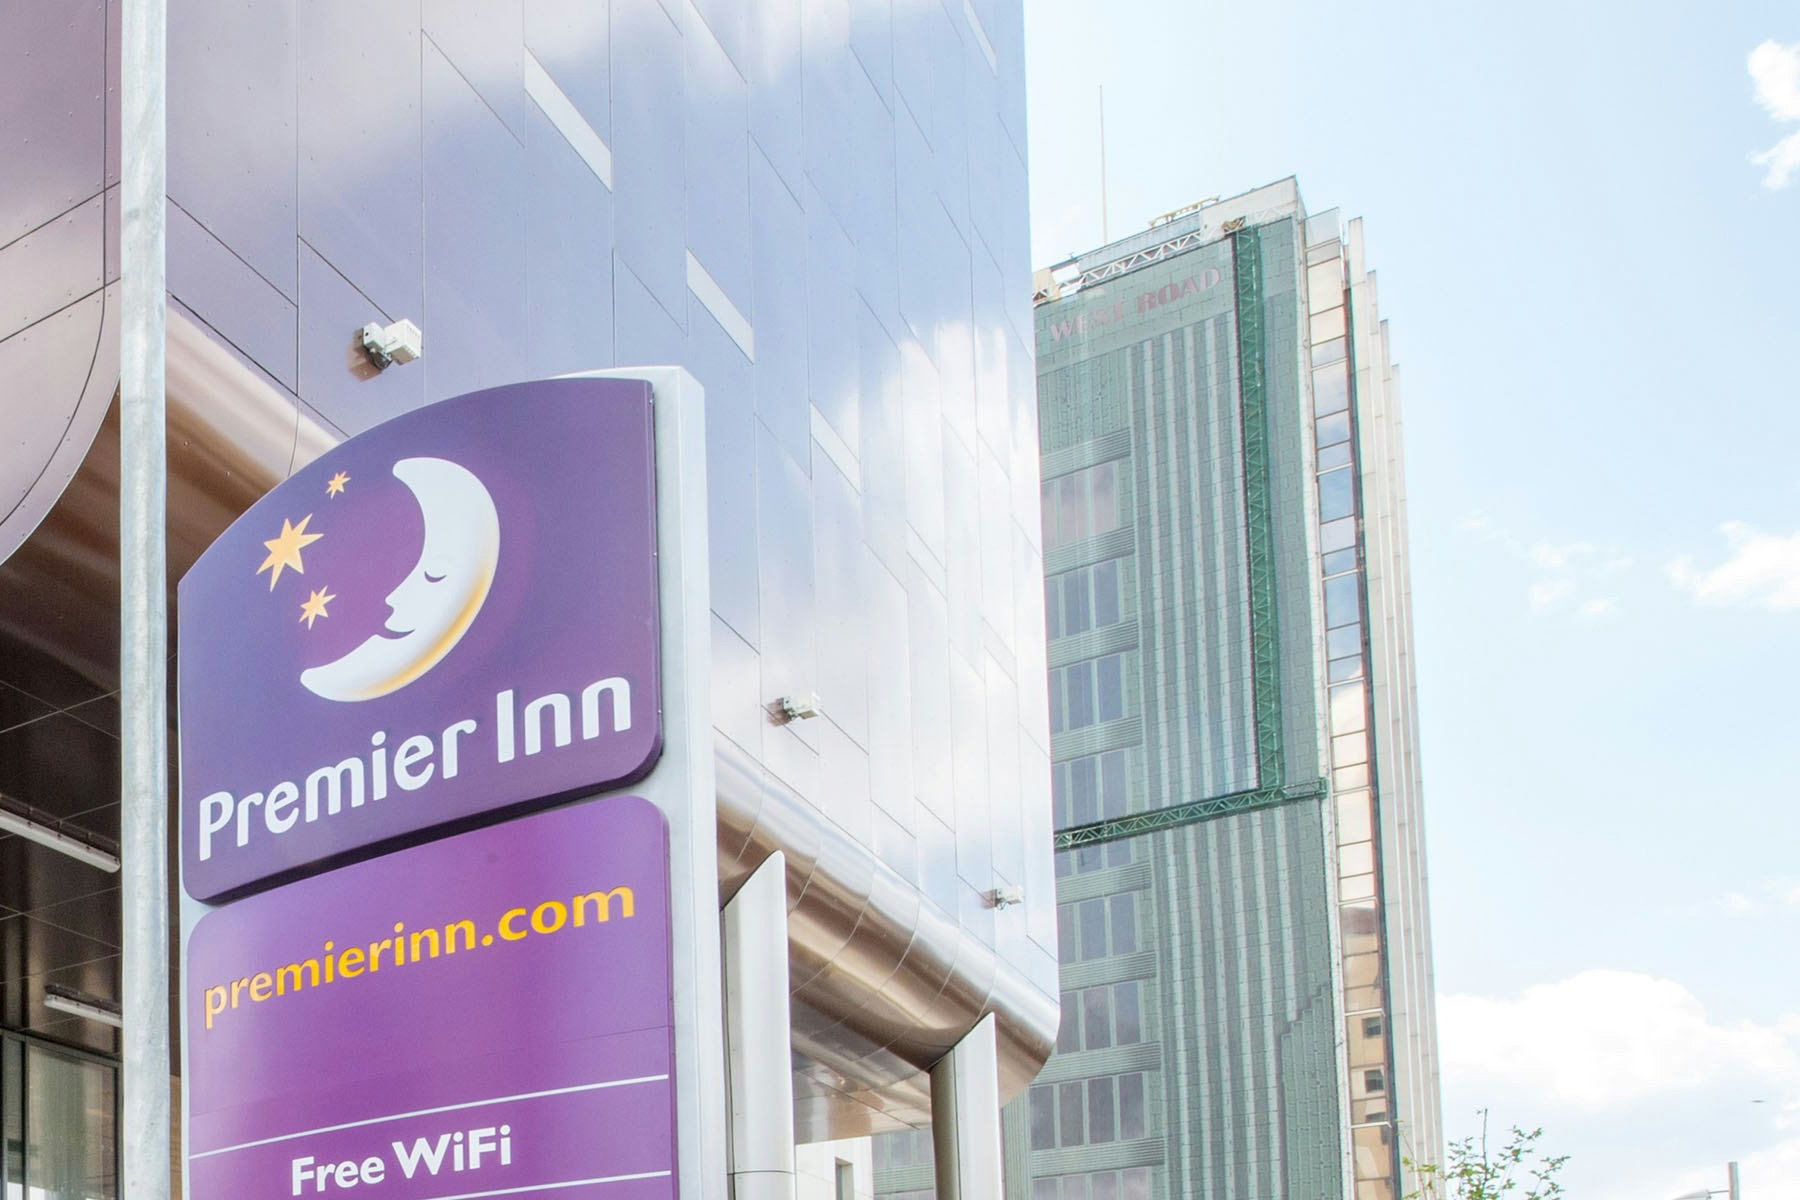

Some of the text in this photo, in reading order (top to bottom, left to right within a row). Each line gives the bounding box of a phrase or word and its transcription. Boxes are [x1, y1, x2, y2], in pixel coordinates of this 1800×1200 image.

[1136, 267, 1221, 314] ROAD
[199, 676, 632, 862] Premier Inn
[203, 885, 635, 1029] premierinn.com
[291, 1125, 512, 1197] Free WiFi
